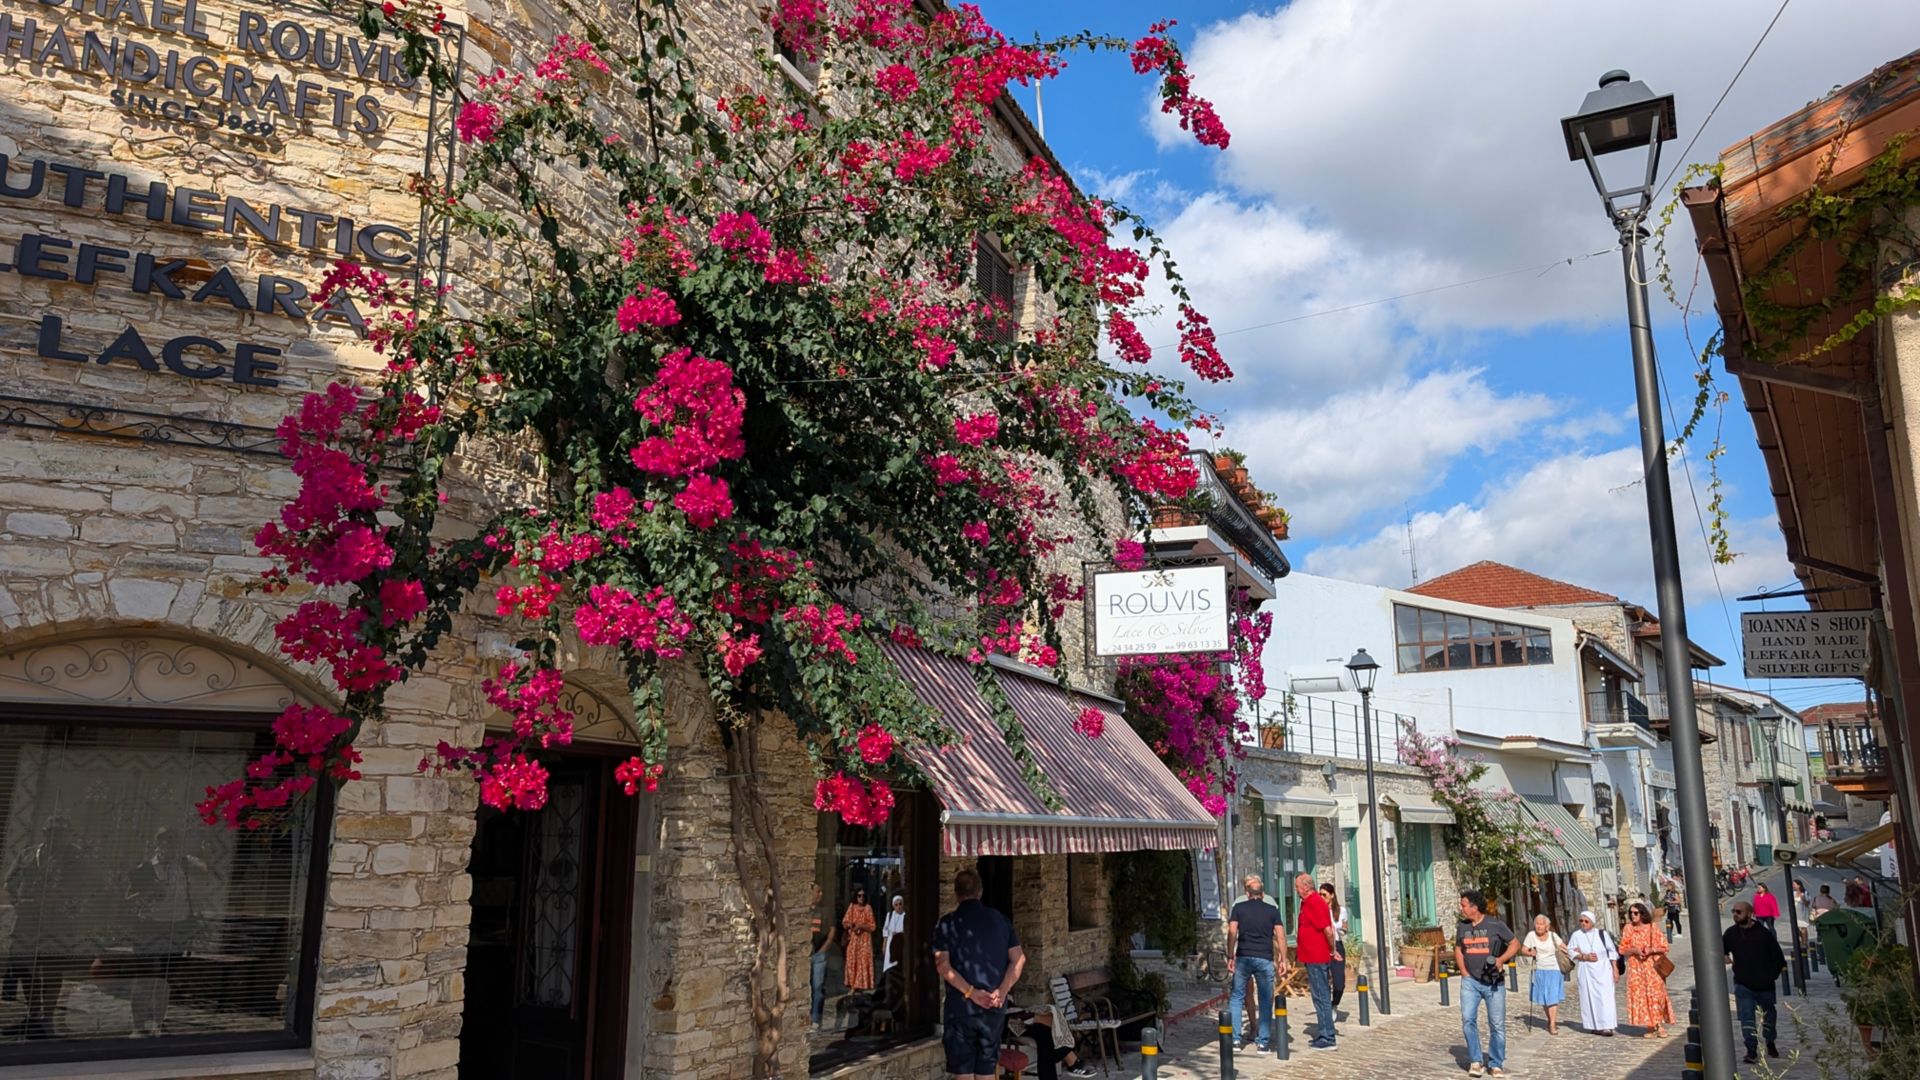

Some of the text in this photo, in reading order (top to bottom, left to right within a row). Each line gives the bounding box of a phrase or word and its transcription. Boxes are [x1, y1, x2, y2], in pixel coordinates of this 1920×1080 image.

[238, 10, 417, 88] ROUVIS
[0, 13, 381, 134] HANDICRAFTS
[110, 89, 275, 138] SINCE 1969
[0, 233, 370, 339] EFKARA
[38, 315, 282, 387] LACE
[1110, 588, 1211, 616] ROUVIS
[1749, 616, 1819, 633] IOANNA'S
[1762, 635, 1860, 647] HAND MADE
[1750, 650, 1822, 660] LEFKARA
[1758, 662, 1861, 673] SILVER GIFTS
